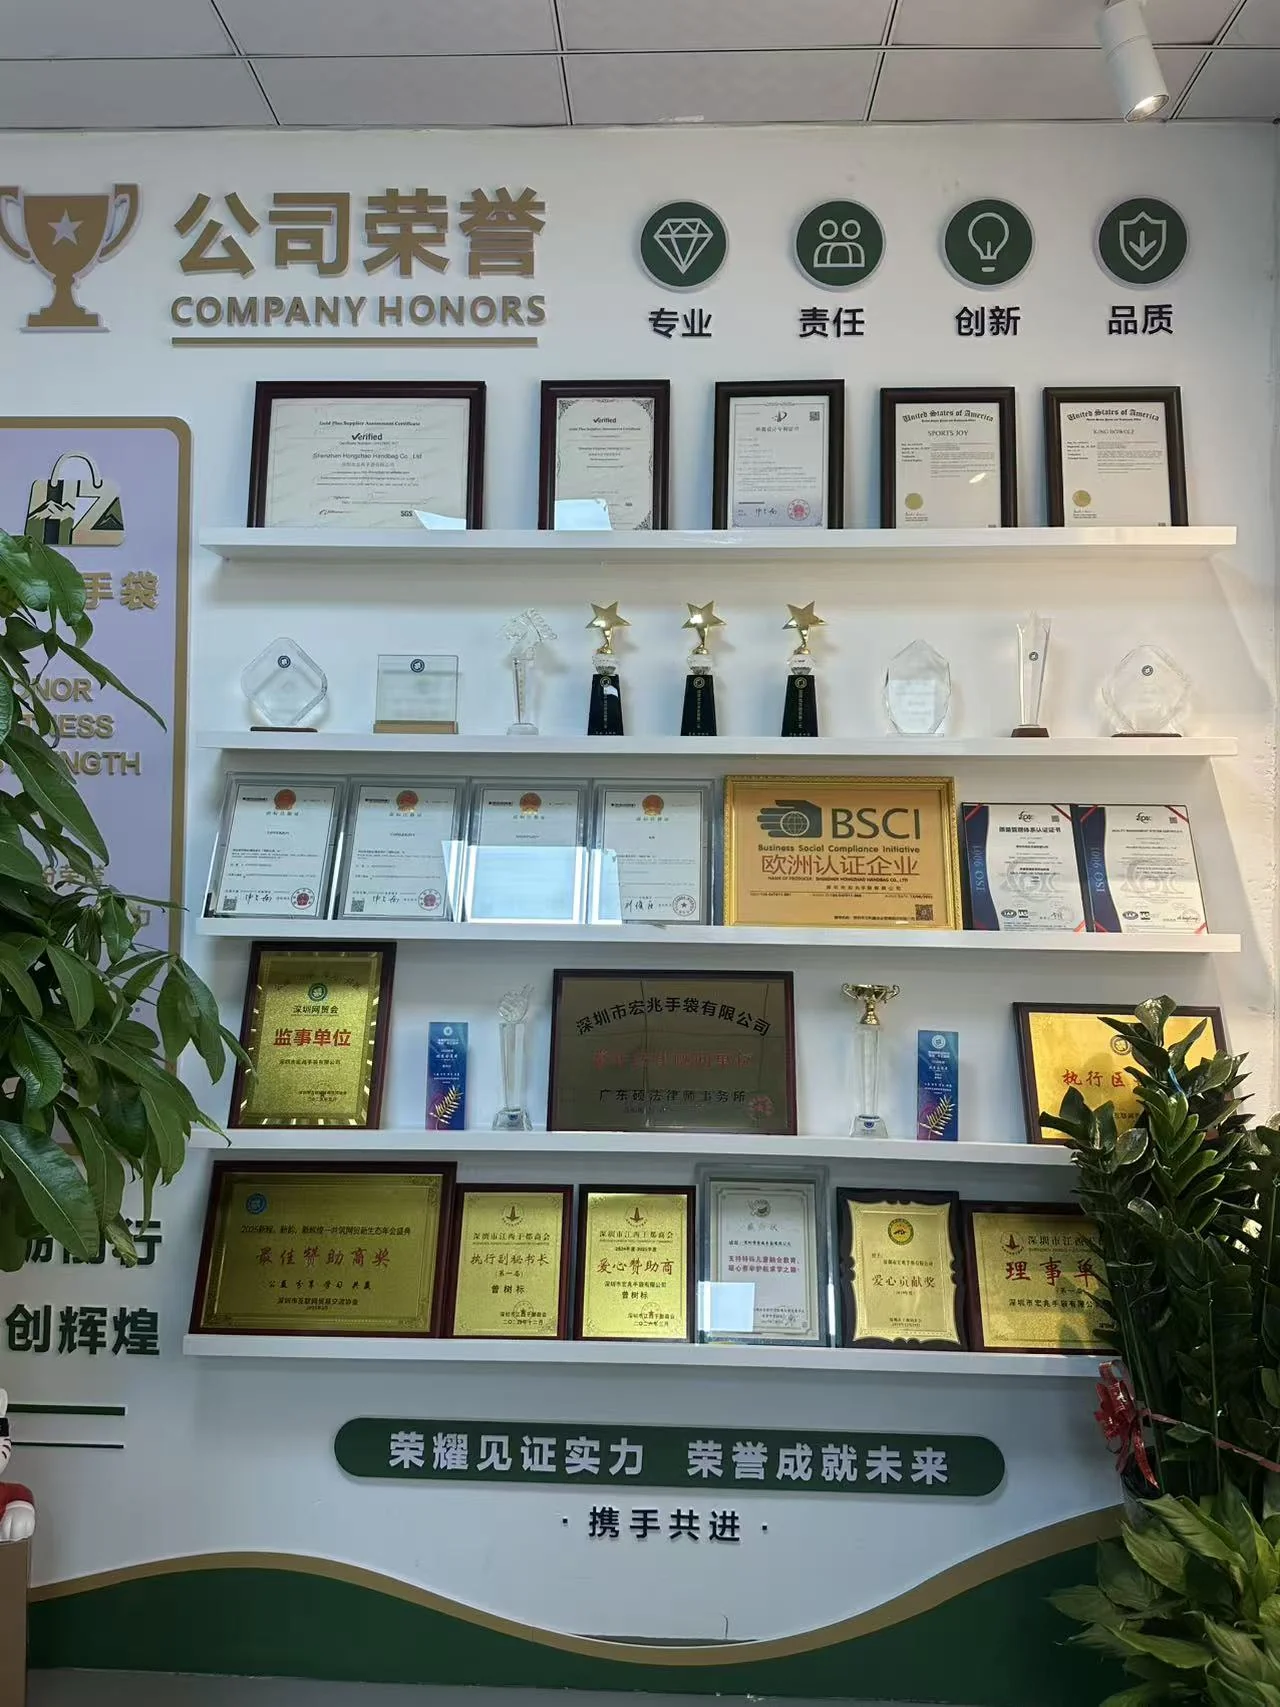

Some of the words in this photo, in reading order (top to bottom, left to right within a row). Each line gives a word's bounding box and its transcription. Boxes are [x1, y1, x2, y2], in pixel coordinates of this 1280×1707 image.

[174, 187, 546, 279] 公司荣誉
[170, 295, 366, 327] COMPANY
[377, 294, 547, 327] HONORS
[647, 307, 713, 338] 专业
[798, 307, 865, 338] 责任
[954, 306, 1021, 337] 创新
[1107, 304, 1174, 336] 品质
[902, 412, 928, 423] United
[929, 409, 954, 417] States
[955, 409, 963, 417] of
[964, 409, 994, 423] America
[1067, 411, 1093, 421] United
[1094, 408, 1119, 416] States
[1120, 408, 1128, 416] of
[1129, 408, 1160, 422] America
[351, 432, 383, 441] Verified
[831, 808, 921, 840] BSCI
[758, 844, 795, 852] Business
[828, 845, 879, 854] Compliance
[883, 845, 920, 853] Initiative
[762, 854, 920, 877] 欧洲认证企业
[575, 997, 772, 1037] 深圳市宏兆手袋有限公司
[273, 1028, 352, 1047] 监事单位
[1062, 1068, 1142, 1089] 执行区
[256, 1246, 391, 1269] 最佳赞助商奖
[470, 1253, 549, 1266] 执行副秘书长
[597, 1257, 675, 1276] 爱心赞助商
[1005, 1257, 1094, 1287] 理事单
[1008, 1298, 1094, 1308] 深圳市宏兆手袋有限公
[5, 1304, 160, 1355] 创辉煌
[388, 1431, 643, 1476] 荣耀见证实力
[686, 1439, 949, 1485] 荣誉成就未来
[588, 1506, 741, 1542] 携手共进
